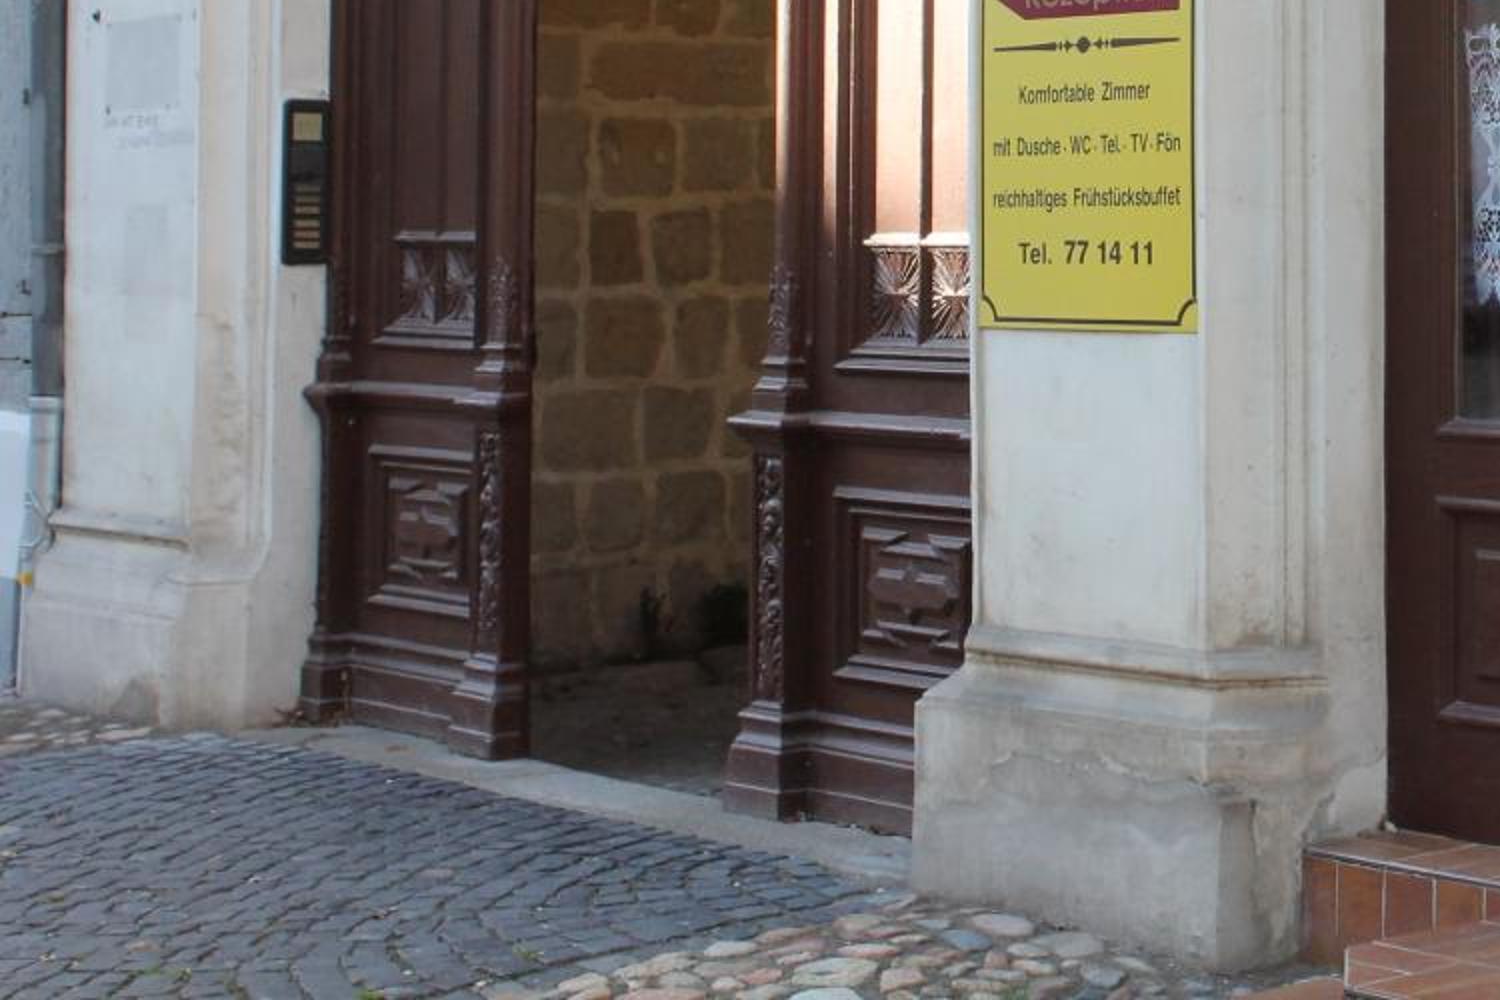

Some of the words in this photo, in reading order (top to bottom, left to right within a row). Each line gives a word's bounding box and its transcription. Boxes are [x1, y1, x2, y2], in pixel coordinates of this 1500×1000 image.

[1019, 83, 1095, 104] Komfortable
[1101, 81, 1151, 100] Zimmer
[993, 138, 1011, 157] mit
[1017, 136, 1061, 155] Dusche
[1069, 135, 1091, 155] WC
[1130, 132, 1150, 152] TV
[1156, 132, 1181, 152] Fön
[993, 189, 1068, 213] reichhaltiges
[1073, 186, 1181, 207] Frühstücksbuffet
[1018, 242, 1052, 265] Tel.
[1063, 240, 1088, 264] 77
[1097, 240, 1122, 264] 14
[1130, 240, 1153, 264] 11
